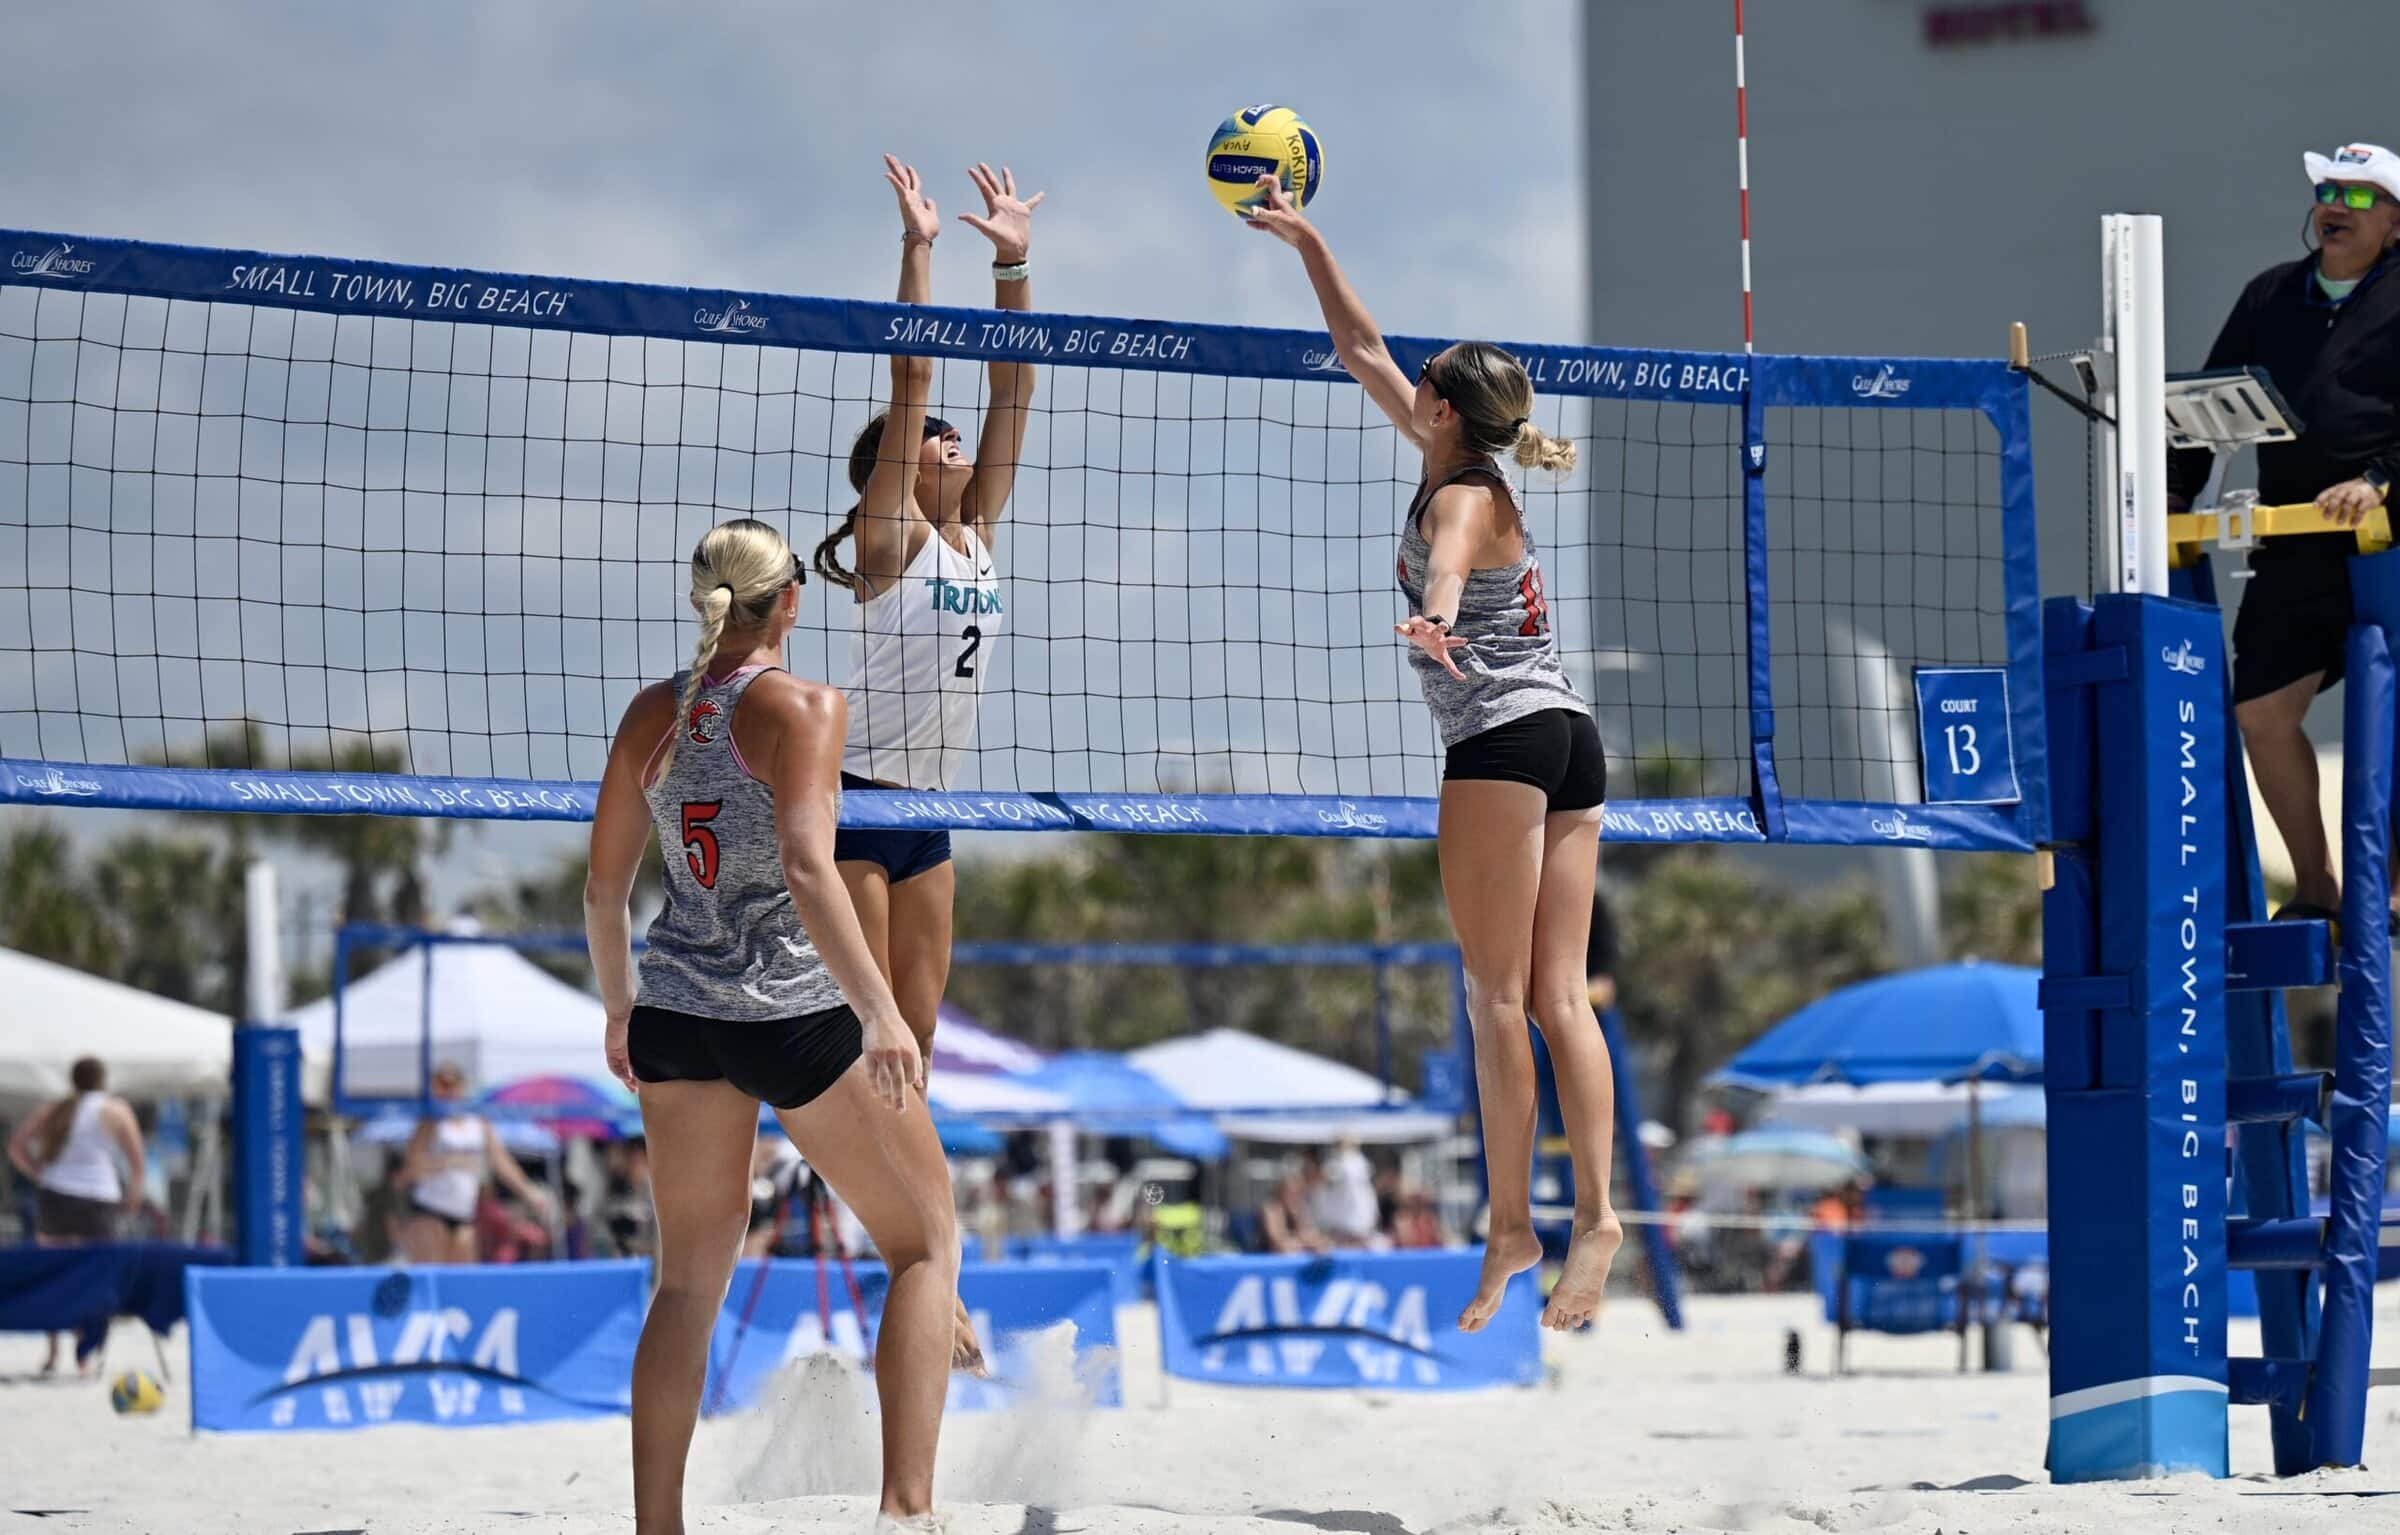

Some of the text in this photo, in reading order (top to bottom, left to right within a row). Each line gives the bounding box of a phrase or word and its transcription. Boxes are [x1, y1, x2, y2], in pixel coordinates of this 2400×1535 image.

[225, 265, 315, 296] SMALL
[330, 273, 414, 310] TOWN,
[427, 282, 472, 309] BIG
[885, 316, 968, 346] SMALL
[979, 323, 1054, 357] TOWN,
[1063, 329, 1104, 354] BIG
[1556, 359, 1626, 391] TOWN,
[1634, 362, 1672, 389] BIG
[954, 624, 982, 678] 2
[1940, 699, 1978, 713] COURT
[1943, 724, 1981, 775] 13
[230, 781, 583, 810] SMALL TOWN, BIG BEACH
[2178, 700, 2197, 866] SMALL
[893, 800, 1209, 825] SMALL TOWN, BIG BEACH
[1650, 811, 1694, 834] BIG
[680, 798, 724, 890] 5
[2178, 887, 2198, 1054] TOWN,
[2181, 1078, 2199, 1159] BIG
